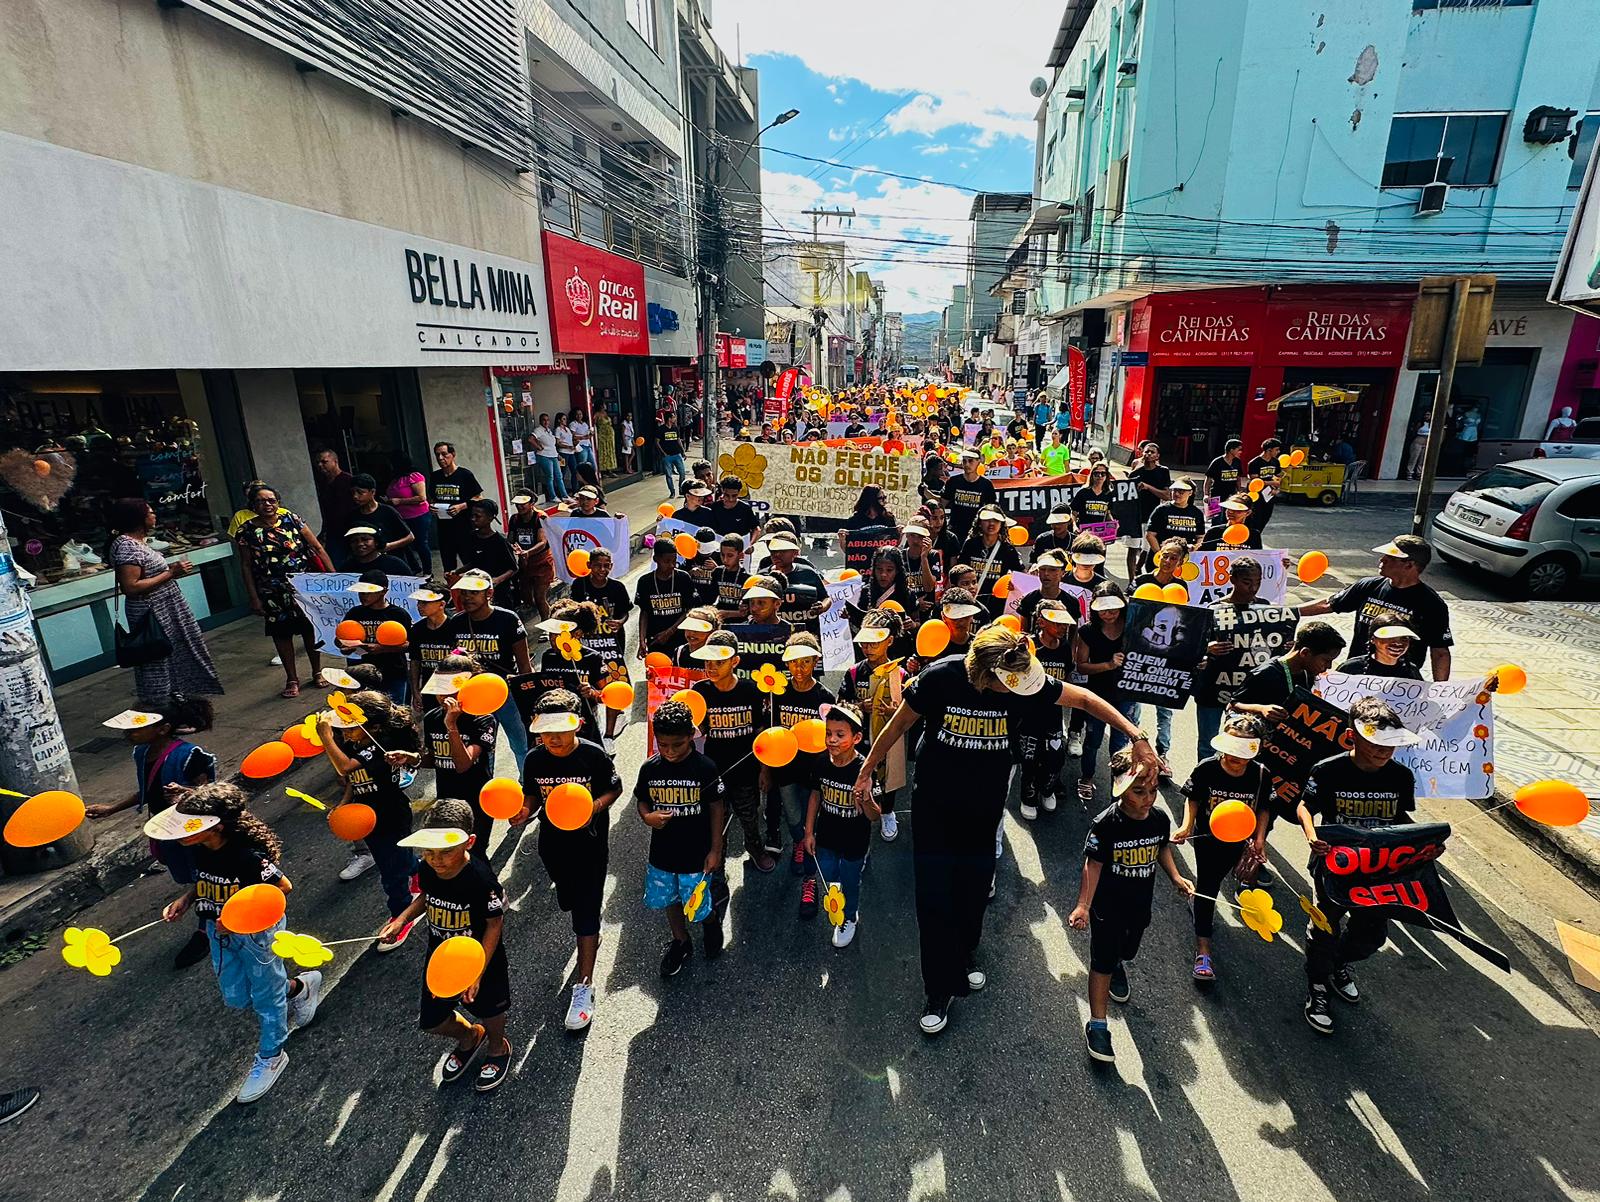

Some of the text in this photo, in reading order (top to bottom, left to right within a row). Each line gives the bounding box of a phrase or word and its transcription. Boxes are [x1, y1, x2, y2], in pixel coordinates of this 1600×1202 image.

[405, 248, 537, 316] BELLA MINA
[599, 275, 635, 298] ÓTICAS
[599, 296, 638, 321] Real
[1205, 315, 1234, 328] DAS
[1338, 313, 1371, 326] DAS
[1487, 316, 1528, 336] AVÉ
[418, 331, 540, 347] CALÇADOS
[1160, 328, 1249, 343] CAPINHAS
[1286, 327, 1387, 341] CAPINHAS
[836, 450, 901, 473] FECHE
[796, 466, 909, 492] OS OLHOS!
[159, 481, 208, 504] comfort
[1004, 489, 1047, 511] TEM
[1200, 555, 1230, 586] 18
[1242, 607, 1297, 625] DIGA
[590, 638, 617, 648] FECHE
[1233, 628, 1283, 649] NÃO
[1124, 661, 1142, 672] SE
[1126, 652, 1167, 667] QUEM
[1239, 651, 1271, 668] AO
[521, 681, 535, 690] SE
[1118, 680, 1180, 699] CULPADO.
[1356, 677, 1421, 699] ABUSO
[710, 711, 752, 728] EDOFILIA
[946, 706, 971, 716] TODOS
[972, 709, 1002, 718] CONTRA
[943, 714, 1008, 736] PEDOFILIA
[1292, 702, 1355, 751] NÃO
[1276, 722, 1313, 750] FINJA
[1425, 738, 1476, 753] MAIS O
[1440, 757, 1471, 775] TEM
[556, 776, 587, 785] CONTRA
[667, 779, 696, 787] CONTRA
[1335, 791, 1365, 799] TODOS
[430, 897, 462, 911] CONTRA
